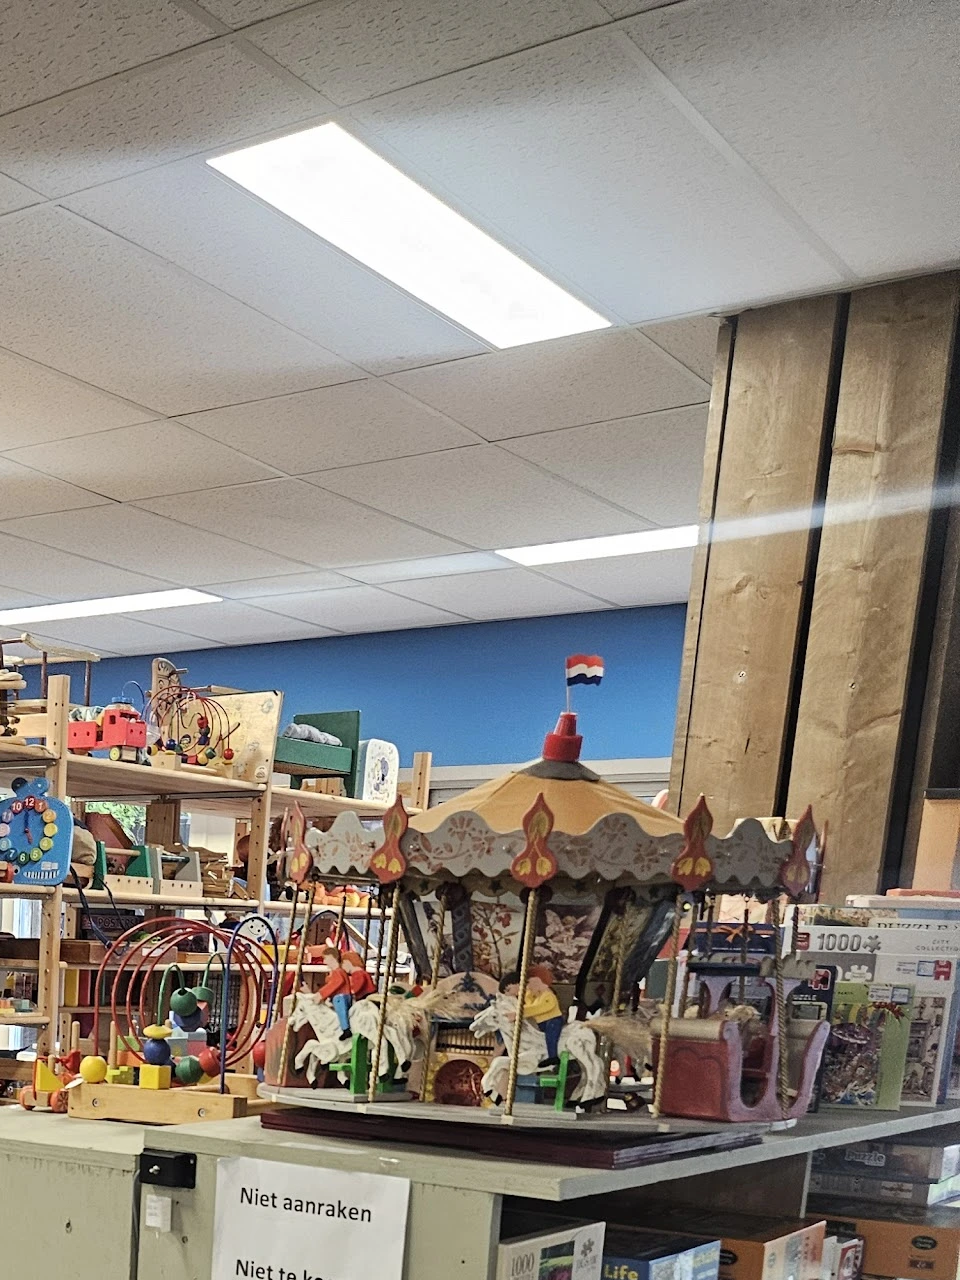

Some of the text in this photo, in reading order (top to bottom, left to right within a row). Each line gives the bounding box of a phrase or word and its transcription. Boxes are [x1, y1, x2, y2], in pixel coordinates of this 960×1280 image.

[11, 802, 22, 811] 10
[24, 798, 35, 806] 12
[39, 802, 43, 810] 1
[2, 812, 12, 820] 11
[46, 811, 53, 819] 2
[42, 840, 48, 848] 4
[9, 849, 15, 858] 7
[21, 853, 26, 862] 6
[32, 850, 39, 859] 5
[817, 933, 862, 952] 1000
[240, 1187, 372, 1223] Niet aanraken
[511, 1253, 535, 1277] 1000
[603, 1264, 639, 1280] Life
